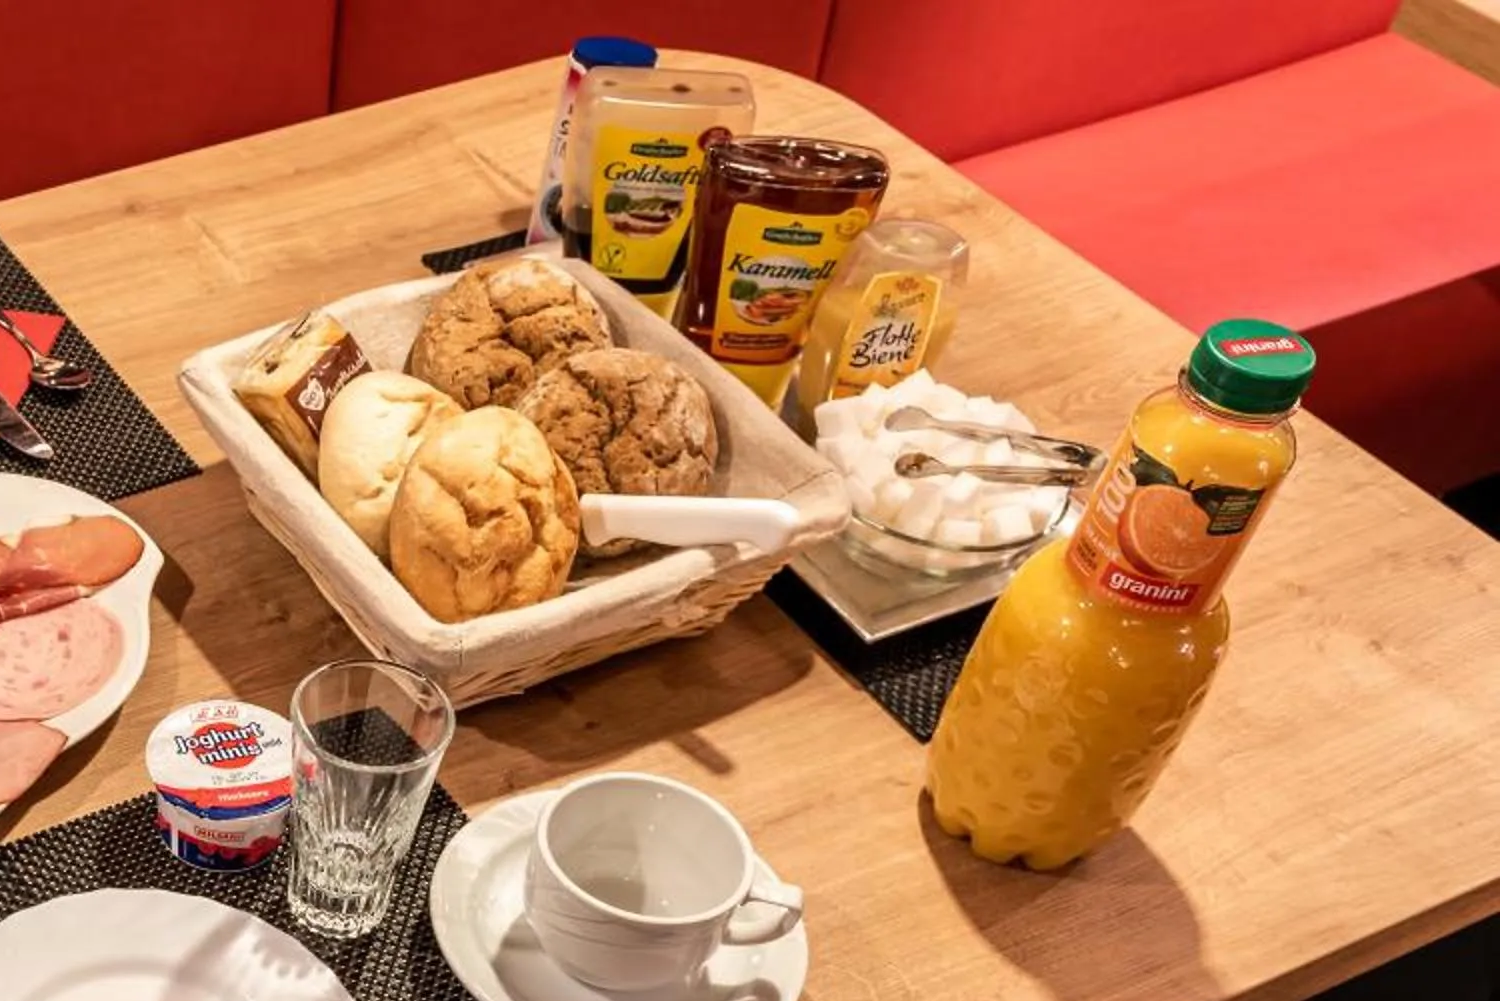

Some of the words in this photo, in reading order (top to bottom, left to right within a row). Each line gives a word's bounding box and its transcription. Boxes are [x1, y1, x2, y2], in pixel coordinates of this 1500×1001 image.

[727, 253, 837, 281] Karamell
[862, 322, 922, 346] Flotte
[849, 342, 916, 368] Biene
[1109, 571, 1189, 601] granini
[174, 721, 265, 756] Joghurt
[199, 740, 264, 766] minis
